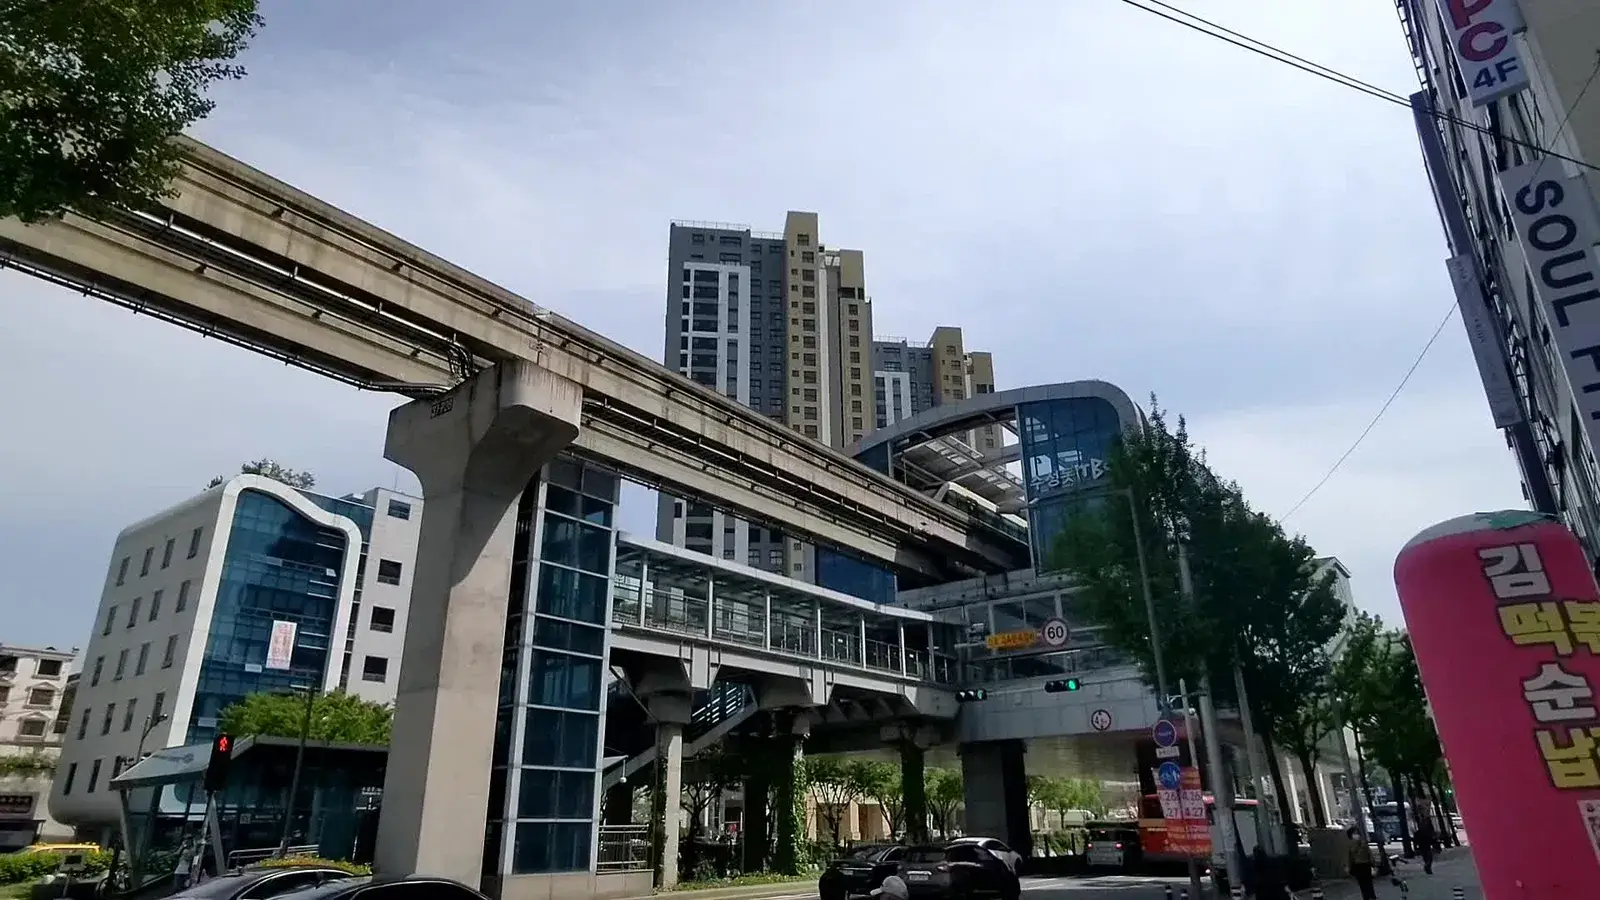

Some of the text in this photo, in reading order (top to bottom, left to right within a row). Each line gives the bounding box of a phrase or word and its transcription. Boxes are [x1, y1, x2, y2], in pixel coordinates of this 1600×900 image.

[1473, 57, 1519, 89] 4F
[1515, 180, 1600, 328] SOUL
[1478, 543, 1552, 599] 김
[1047, 626, 1064, 639] 60
[1523, 663, 1597, 722] 순
